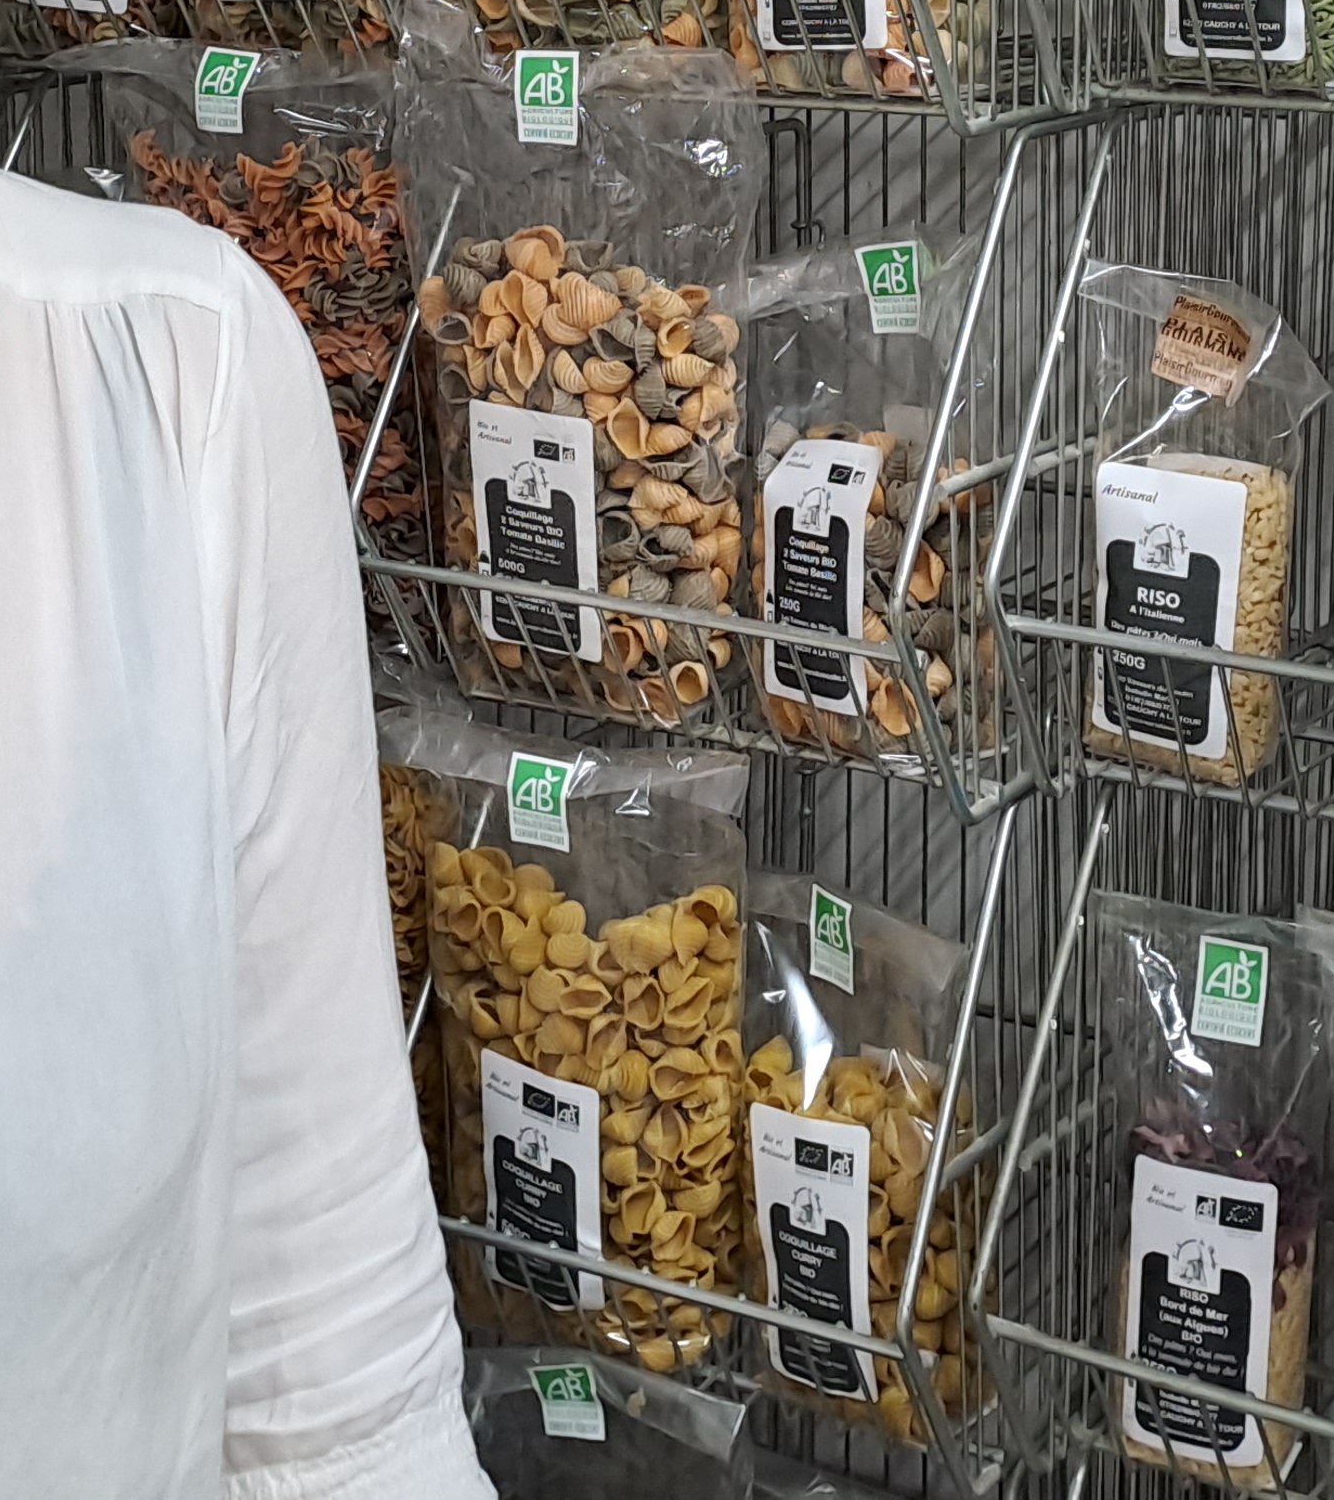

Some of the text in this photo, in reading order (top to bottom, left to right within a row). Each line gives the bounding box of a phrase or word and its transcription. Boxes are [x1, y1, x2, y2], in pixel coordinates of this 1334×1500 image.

[202, 66, 238, 95] AB
[524, 73, 566, 106] AB
[873, 263, 907, 294] AB
[1102, 483, 1159, 505] Artisanal
[1137, 586, 1180, 609] RISO
[516, 779, 554, 812] AB
[1205, 962, 1252, 1000] AB
[1180, 1287, 1209, 1304] RISO
